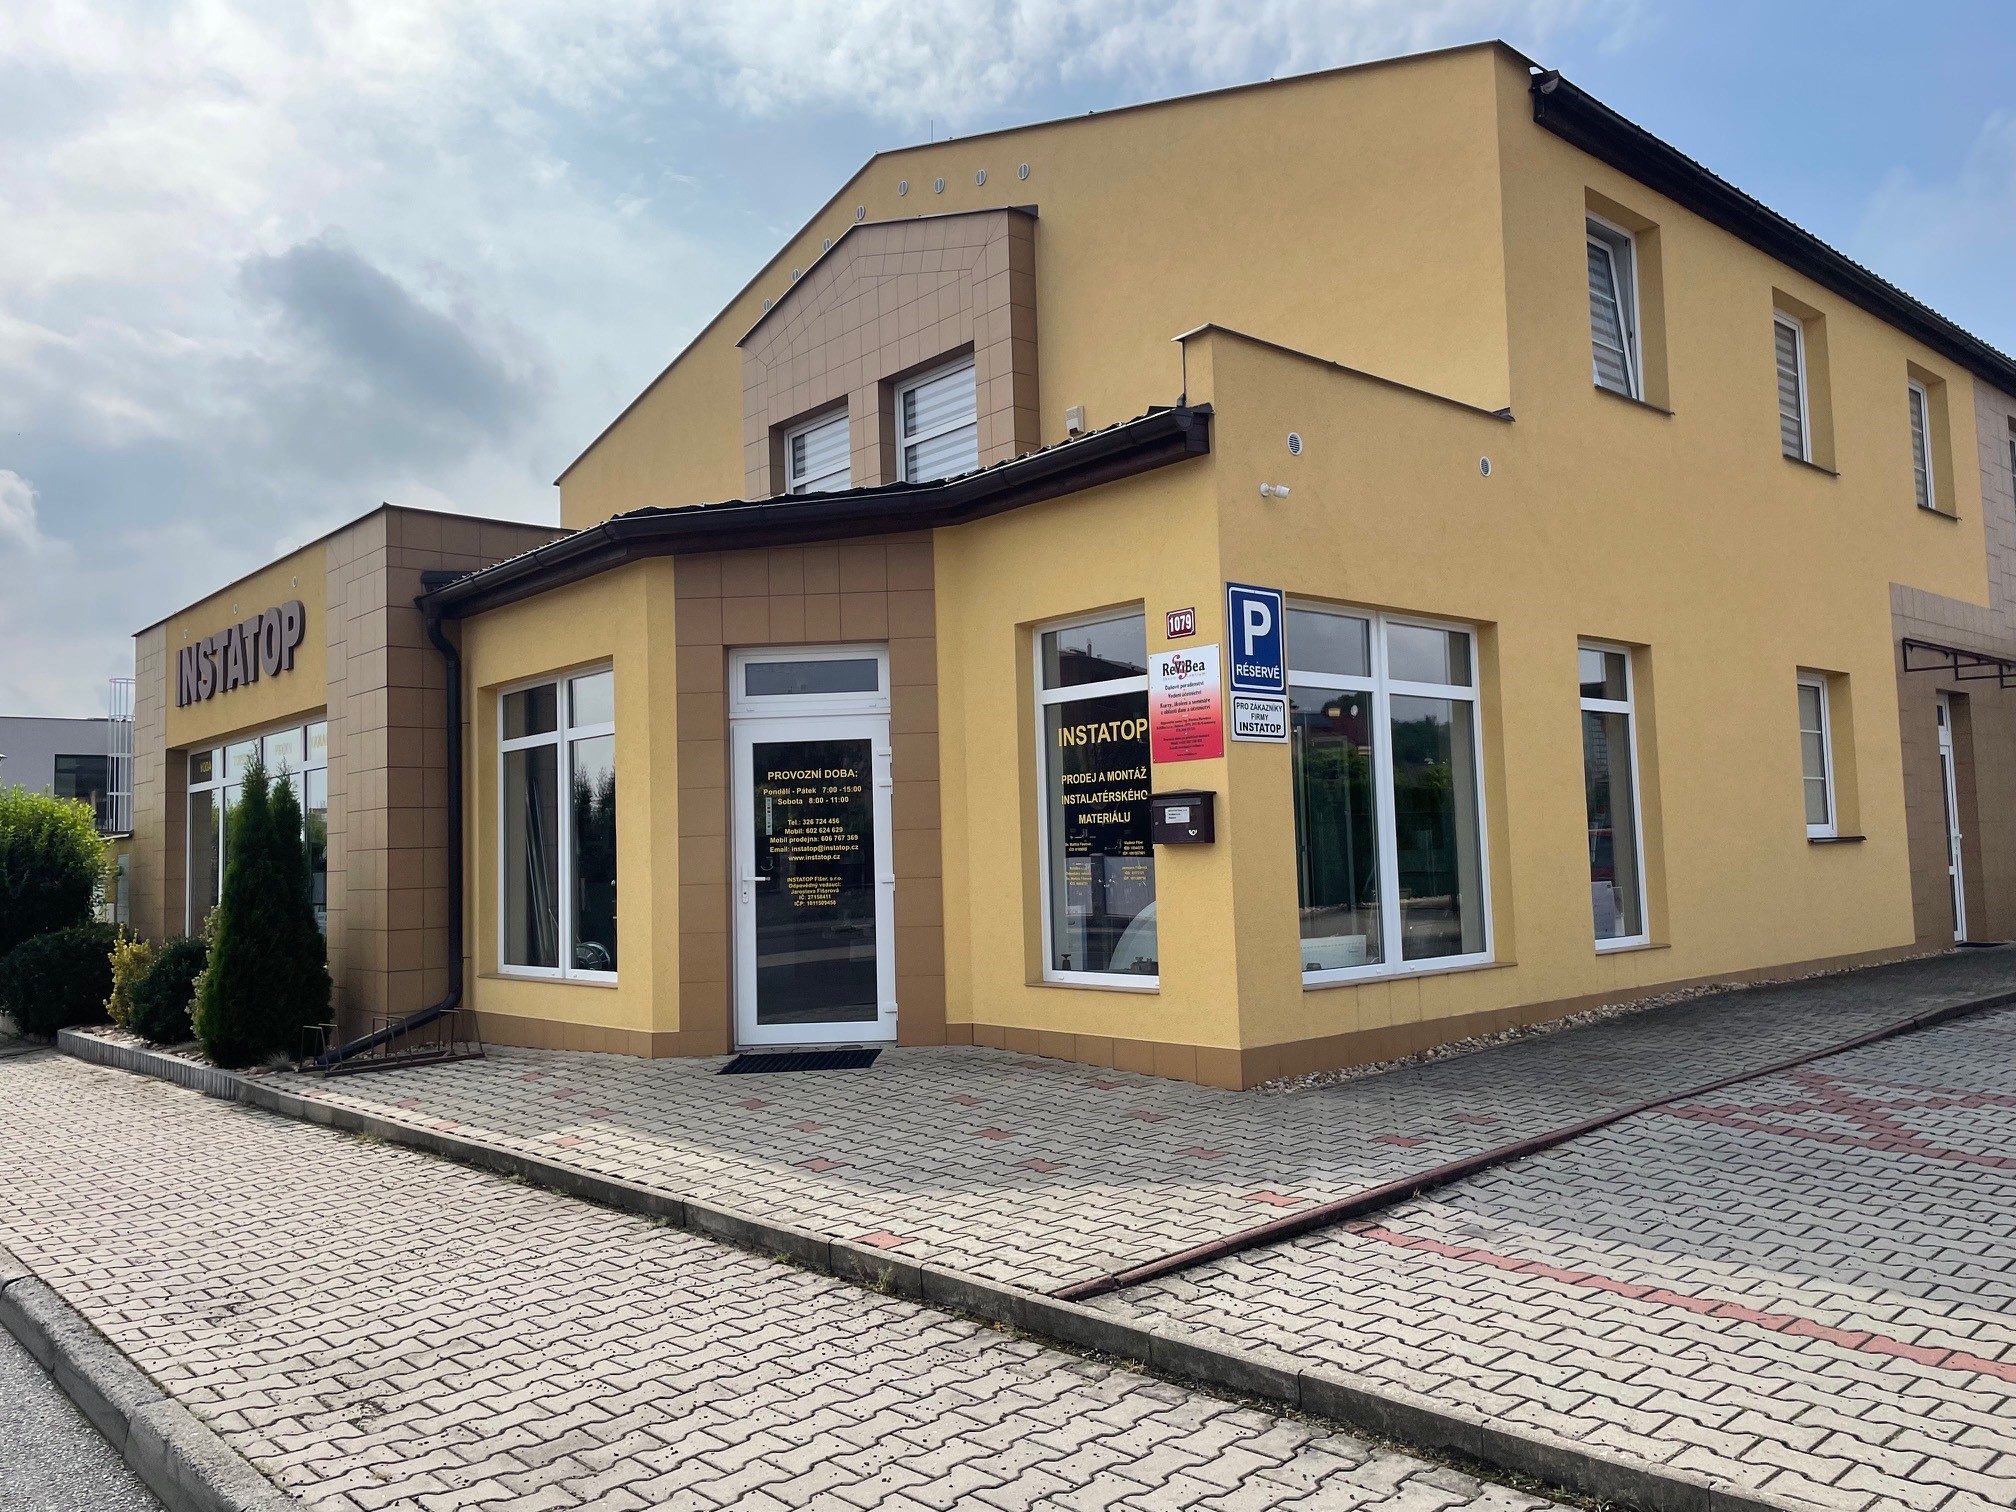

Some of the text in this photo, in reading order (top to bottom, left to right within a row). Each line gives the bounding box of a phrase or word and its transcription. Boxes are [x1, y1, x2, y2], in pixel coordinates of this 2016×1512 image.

[1169, 614, 1192, 632] 1079
[1243, 600, 1271, 656] P
[176, 600, 305, 707] INSTATOP
[1162, 659, 1205, 677] ReViBea
[1236, 661, 1281, 679] RÉSERVÉ
[1236, 702, 1282, 712] PRO ZÁKAZNÍKY
[1058, 718, 1148, 747] INSTATOP
[1239, 722, 1282, 733] INSTATOP
[767, 768, 858, 780] PROVOZNÍ DOBA:
[1061, 766, 1147, 785] PRODEJ A MONTÁŽ
[763, 787, 791, 795] Pondělí
[796, 786, 817, 794] Pátek
[1061, 788, 1148, 805] INSTALATÉRSKÉHO
[777, 797, 803, 805] Sobota
[831, 796, 849, 804] 11:00
[1079, 809, 1131, 824] MATERIÁLU
[791, 845, 859, 853] instatop@instatop.cz
